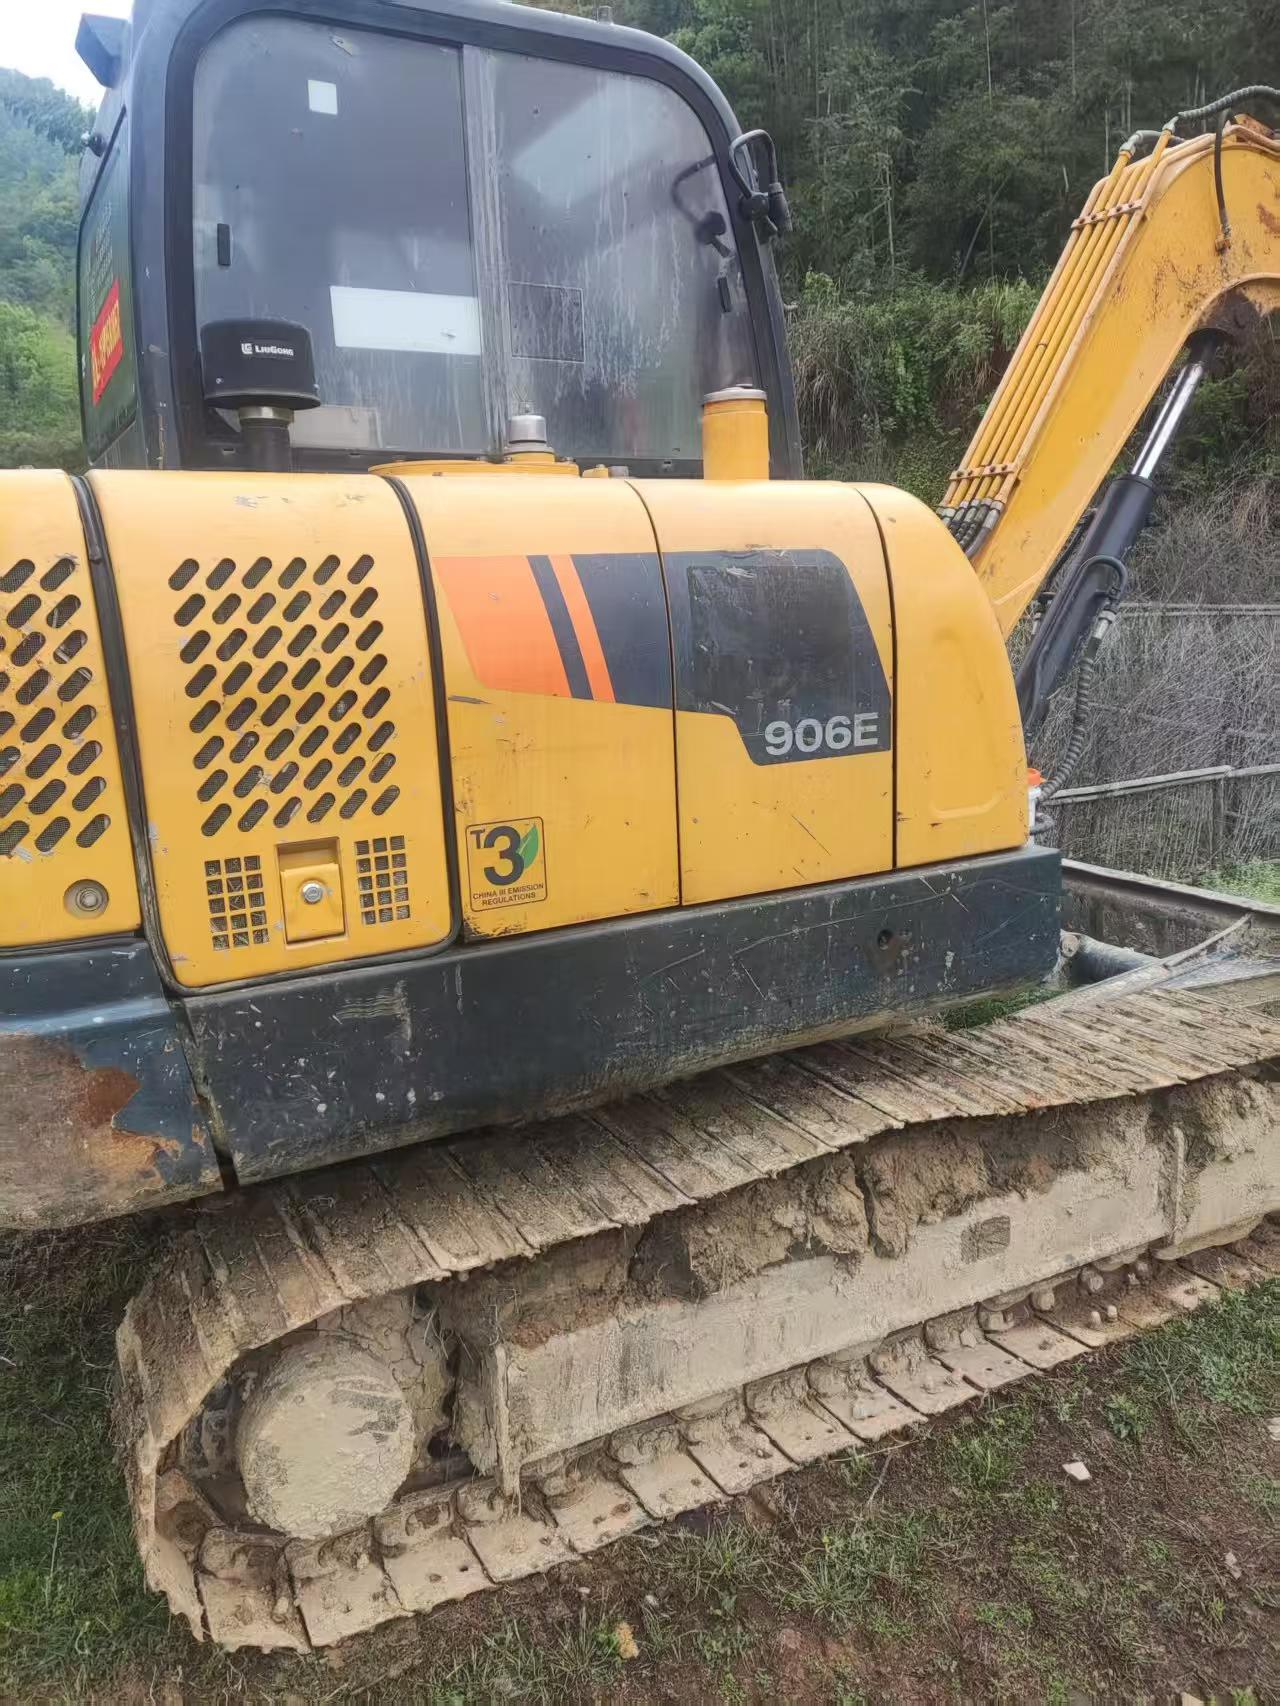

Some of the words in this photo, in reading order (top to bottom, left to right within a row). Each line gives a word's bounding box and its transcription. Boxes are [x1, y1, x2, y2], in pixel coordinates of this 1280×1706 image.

[764, 712, 879, 756] 906E
[473, 891, 497, 900] CHINA
[508, 883, 544, 895] EMISSION
[482, 891, 536, 906] REGULATIONS
